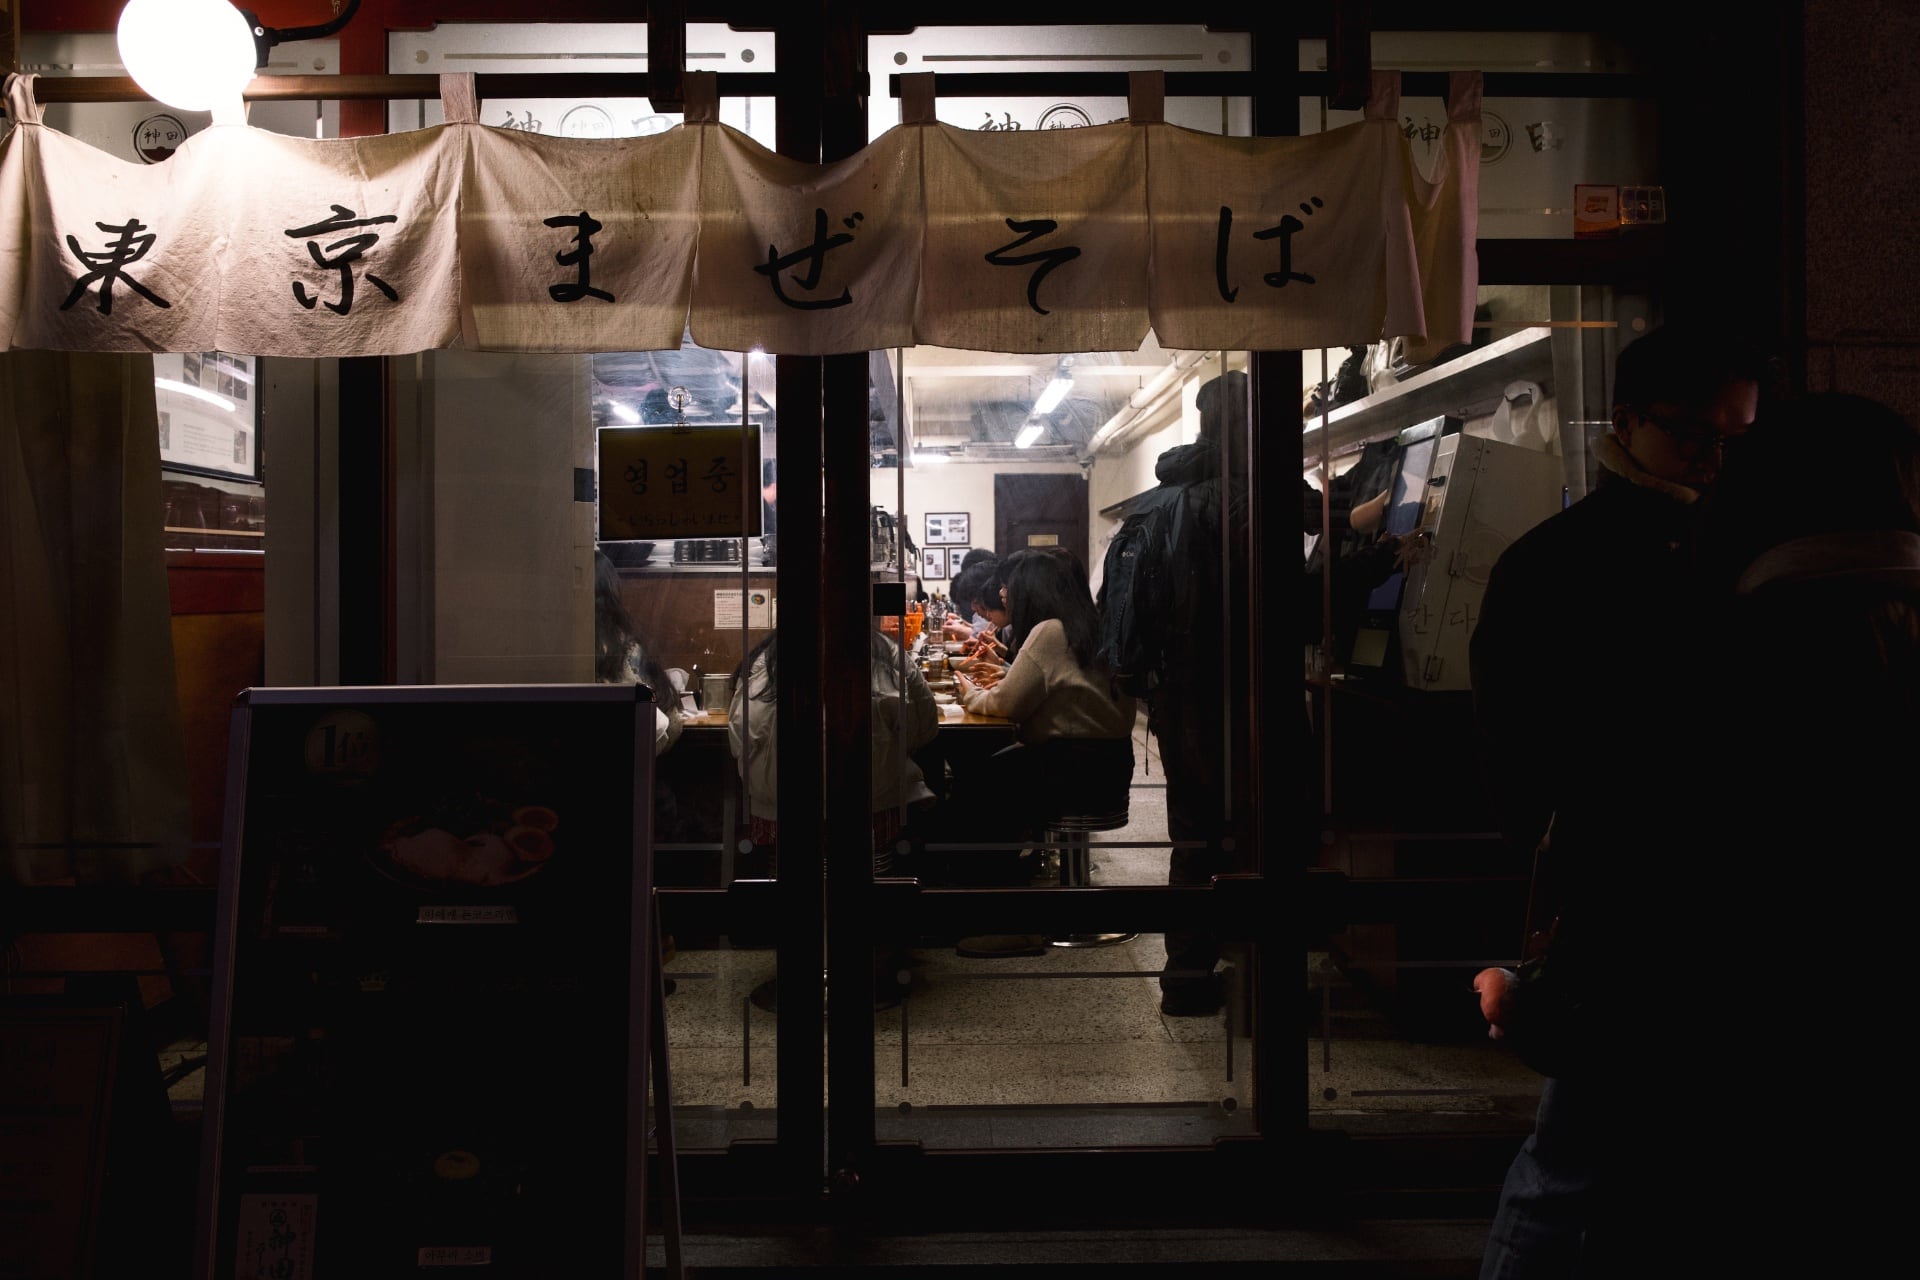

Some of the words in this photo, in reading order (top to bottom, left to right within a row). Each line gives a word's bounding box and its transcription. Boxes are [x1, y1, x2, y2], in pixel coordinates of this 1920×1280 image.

[143, 127, 179, 145] 神田
[61, 196, 1323, 316] 東京まぜそば
[623, 455, 738, 496] 영업중
